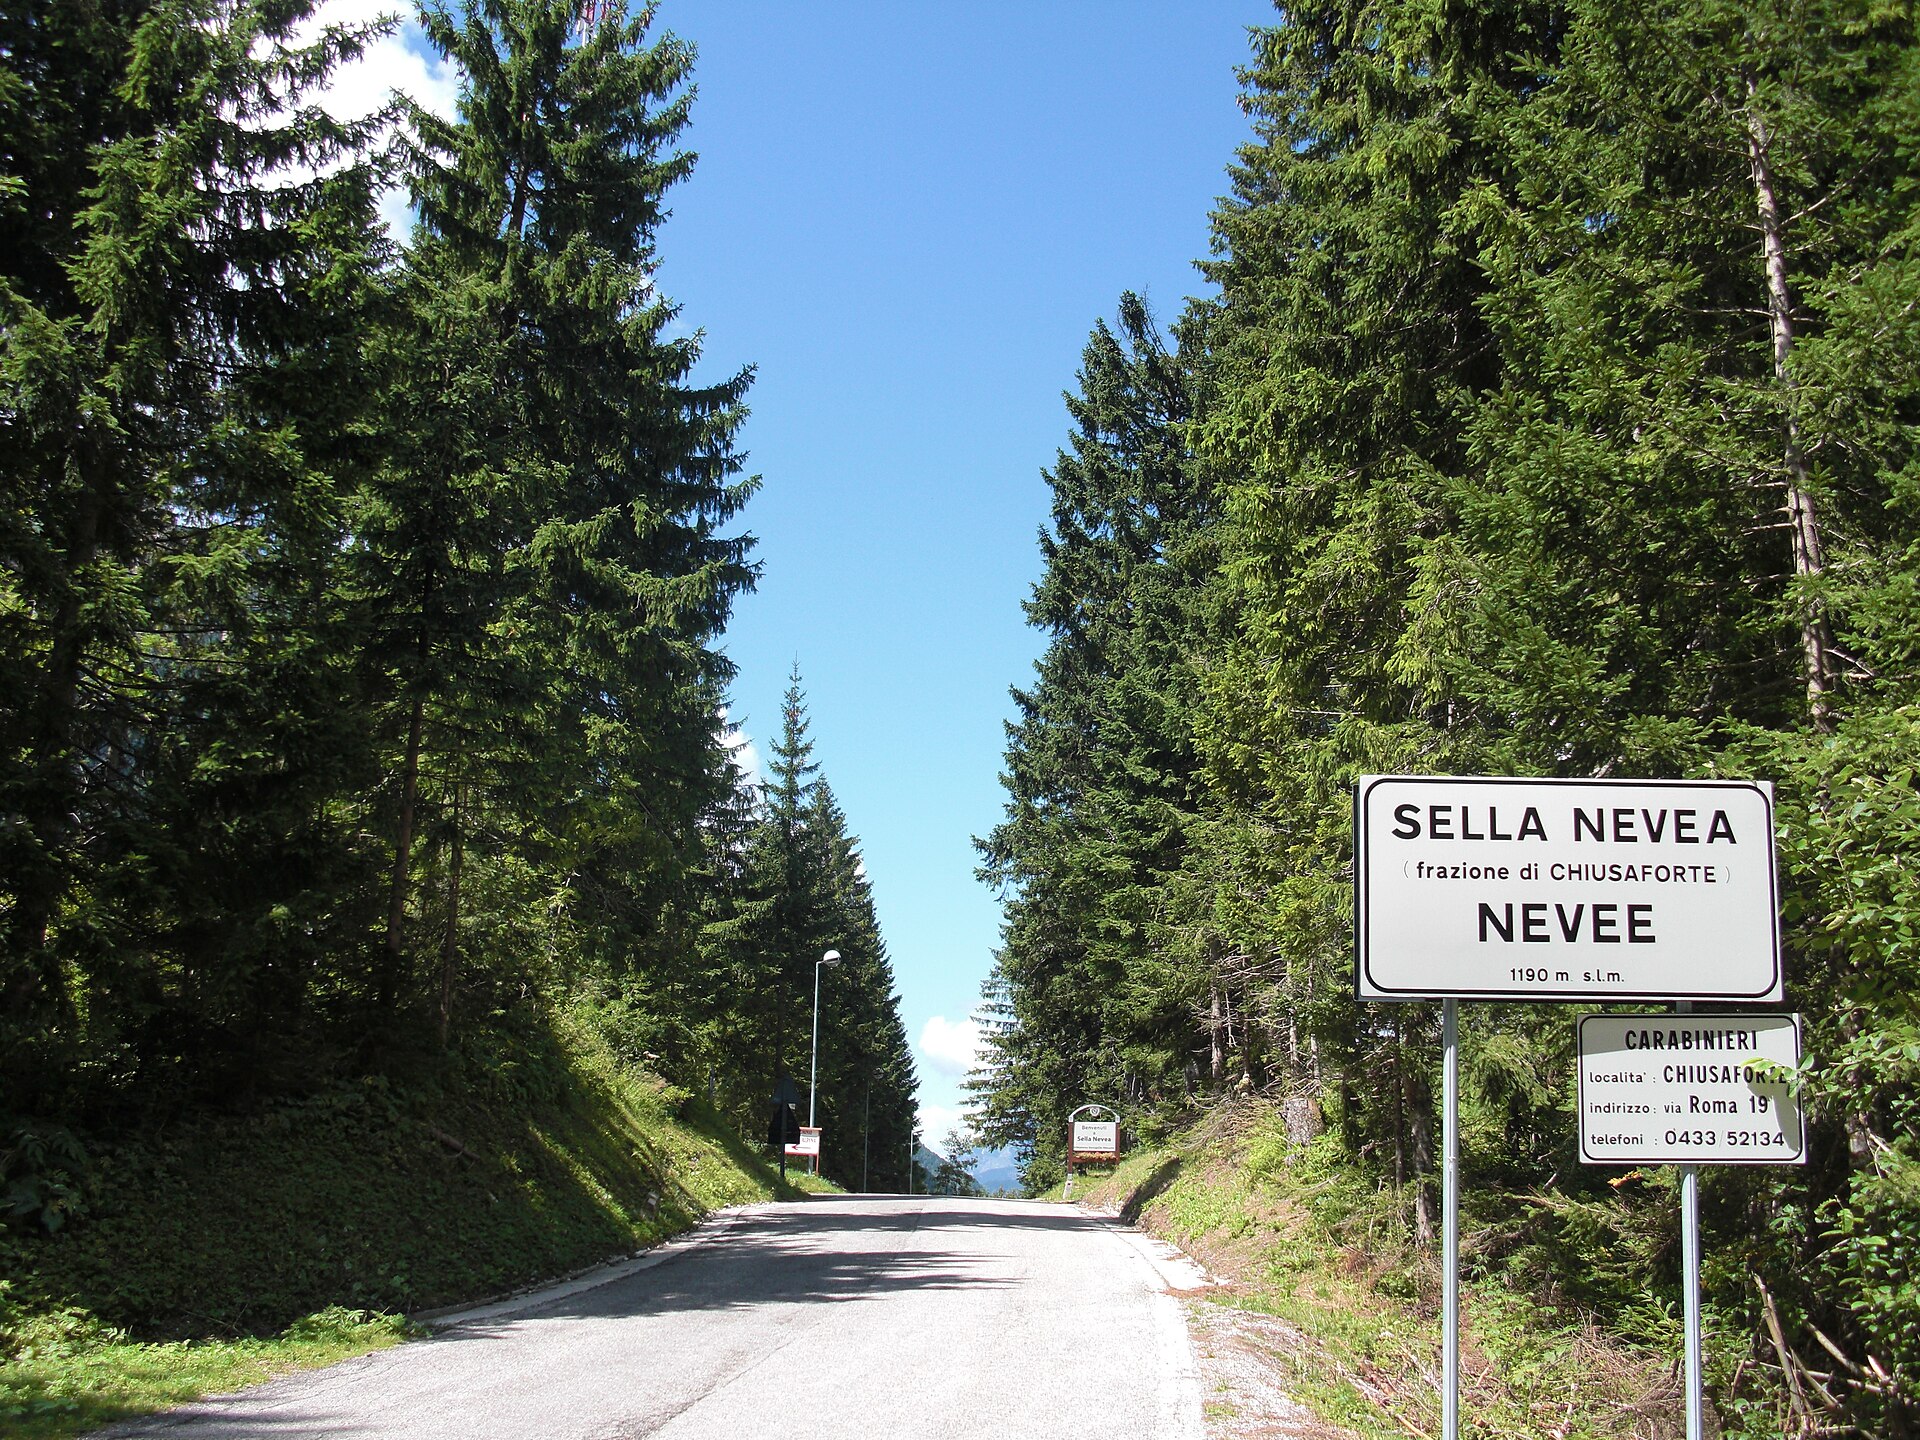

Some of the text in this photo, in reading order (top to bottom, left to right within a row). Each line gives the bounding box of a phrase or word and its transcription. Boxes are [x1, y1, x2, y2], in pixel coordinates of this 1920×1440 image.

[1391, 803, 1737, 844] SELLA NEVEA
[1519, 863, 1539, 881] di
[1478, 902, 1656, 943] NEVEE
[1510, 968, 1549, 982] 1190
[1583, 969, 1625, 982] s.l.m.
[1625, 1029, 1757, 1050] CARABINIERI
[1663, 1101, 1682, 1114] via
[1689, 1095, 1738, 1114] Roma
[1749, 1095, 1769, 1114] 19
[1590, 1133, 1644, 1145] telefoni
